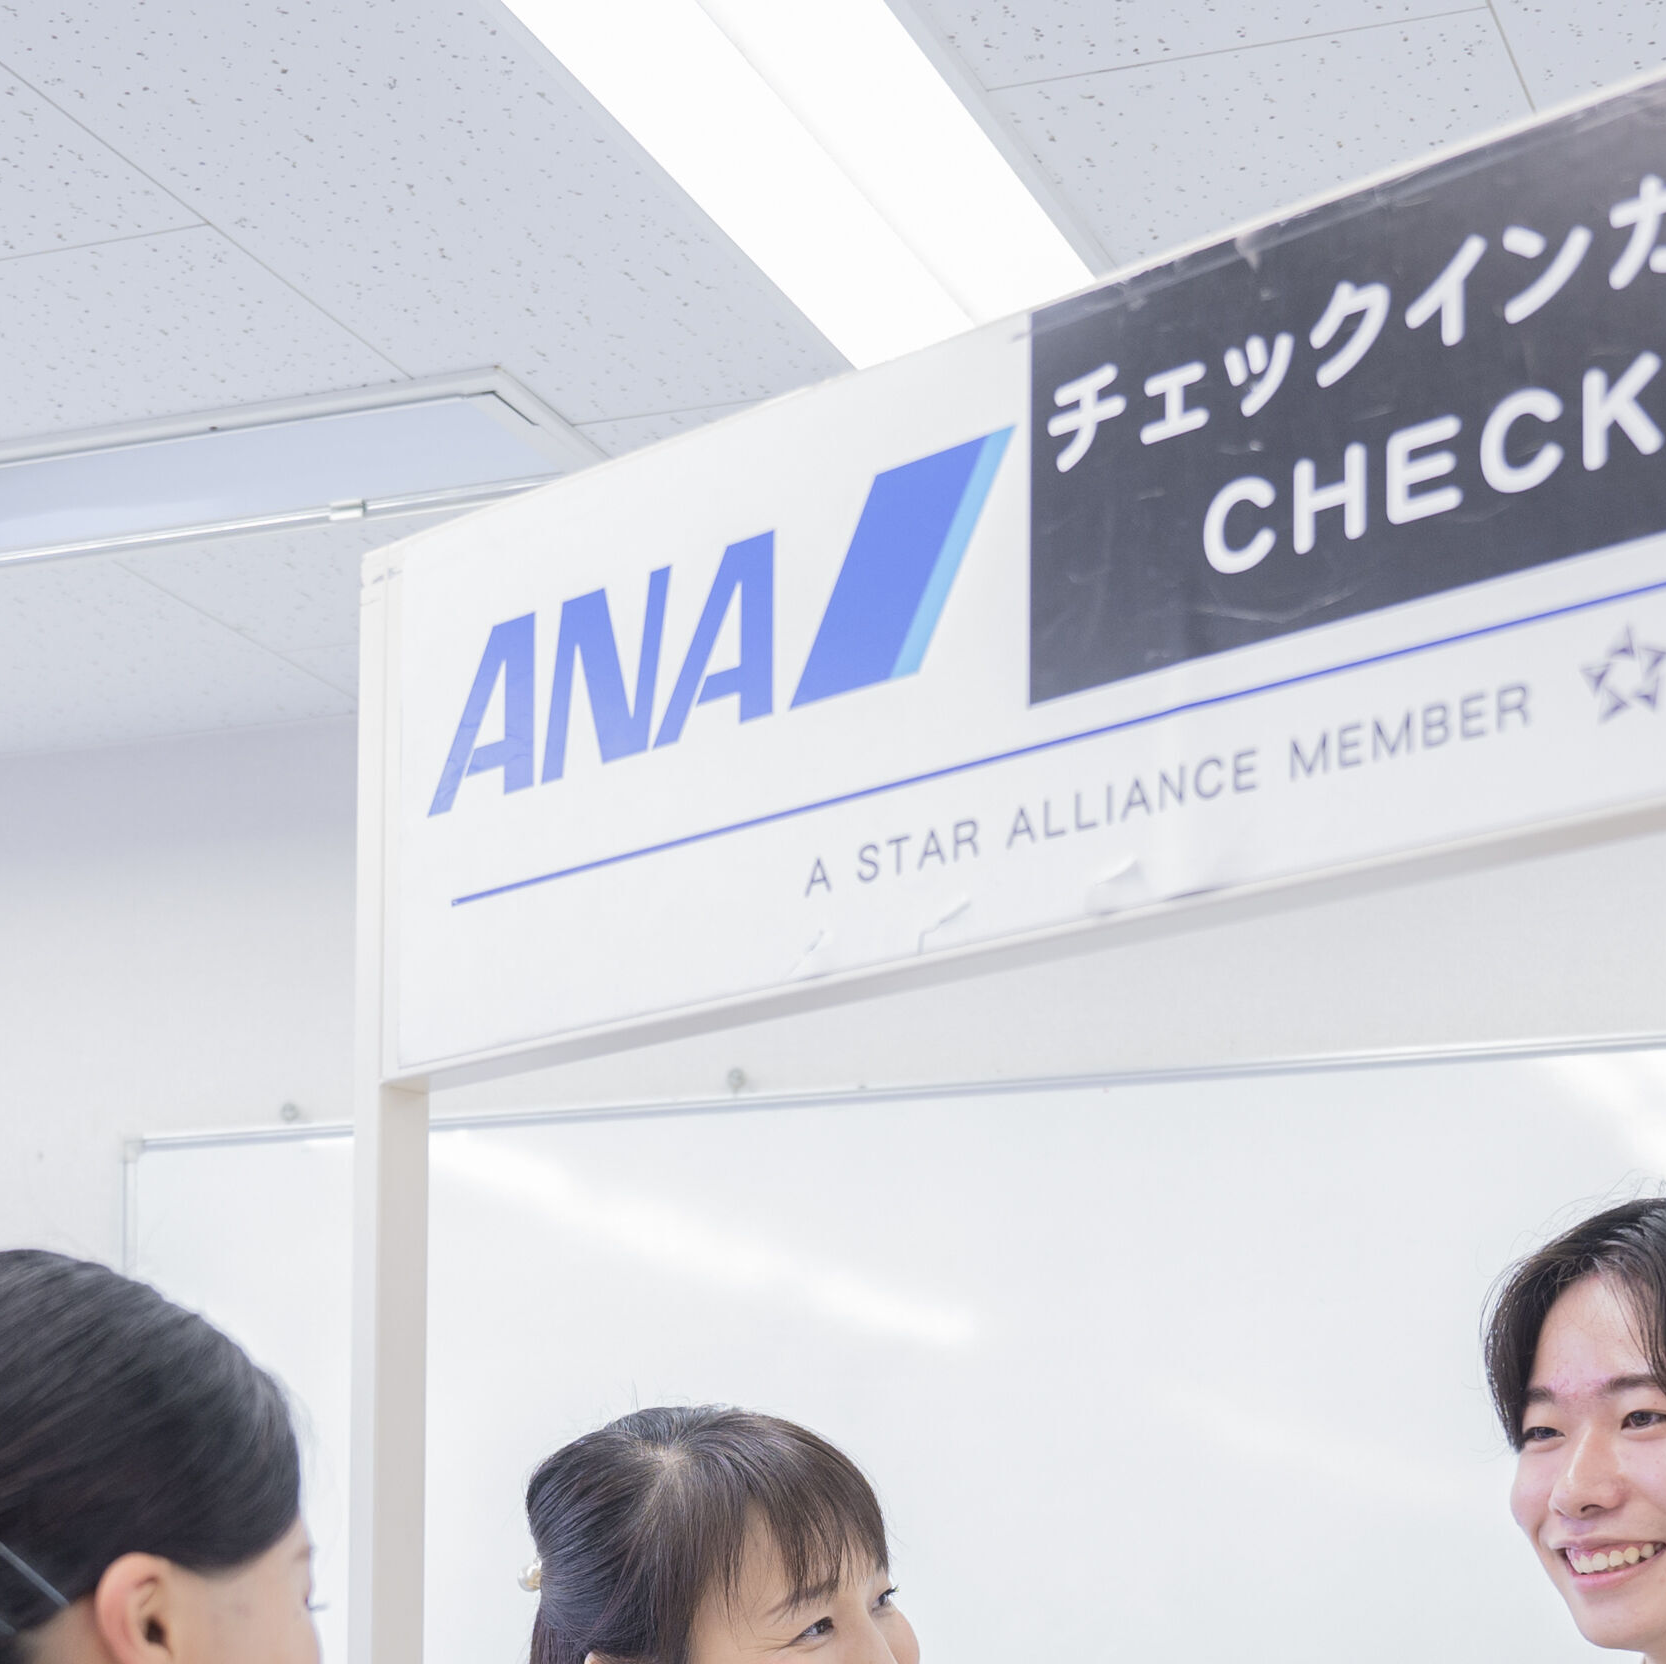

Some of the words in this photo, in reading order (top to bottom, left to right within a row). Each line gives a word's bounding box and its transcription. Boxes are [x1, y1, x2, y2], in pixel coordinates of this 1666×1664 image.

[1202, 351, 1664, 575] CHECK
[427, 528, 775, 818] ANA
[804, 858, 832, 897] A
[856, 820, 981, 882] STAR
[1005, 749, 1259, 850] ALLIANCE
[1289, 683, 1534, 780] MEMBER
